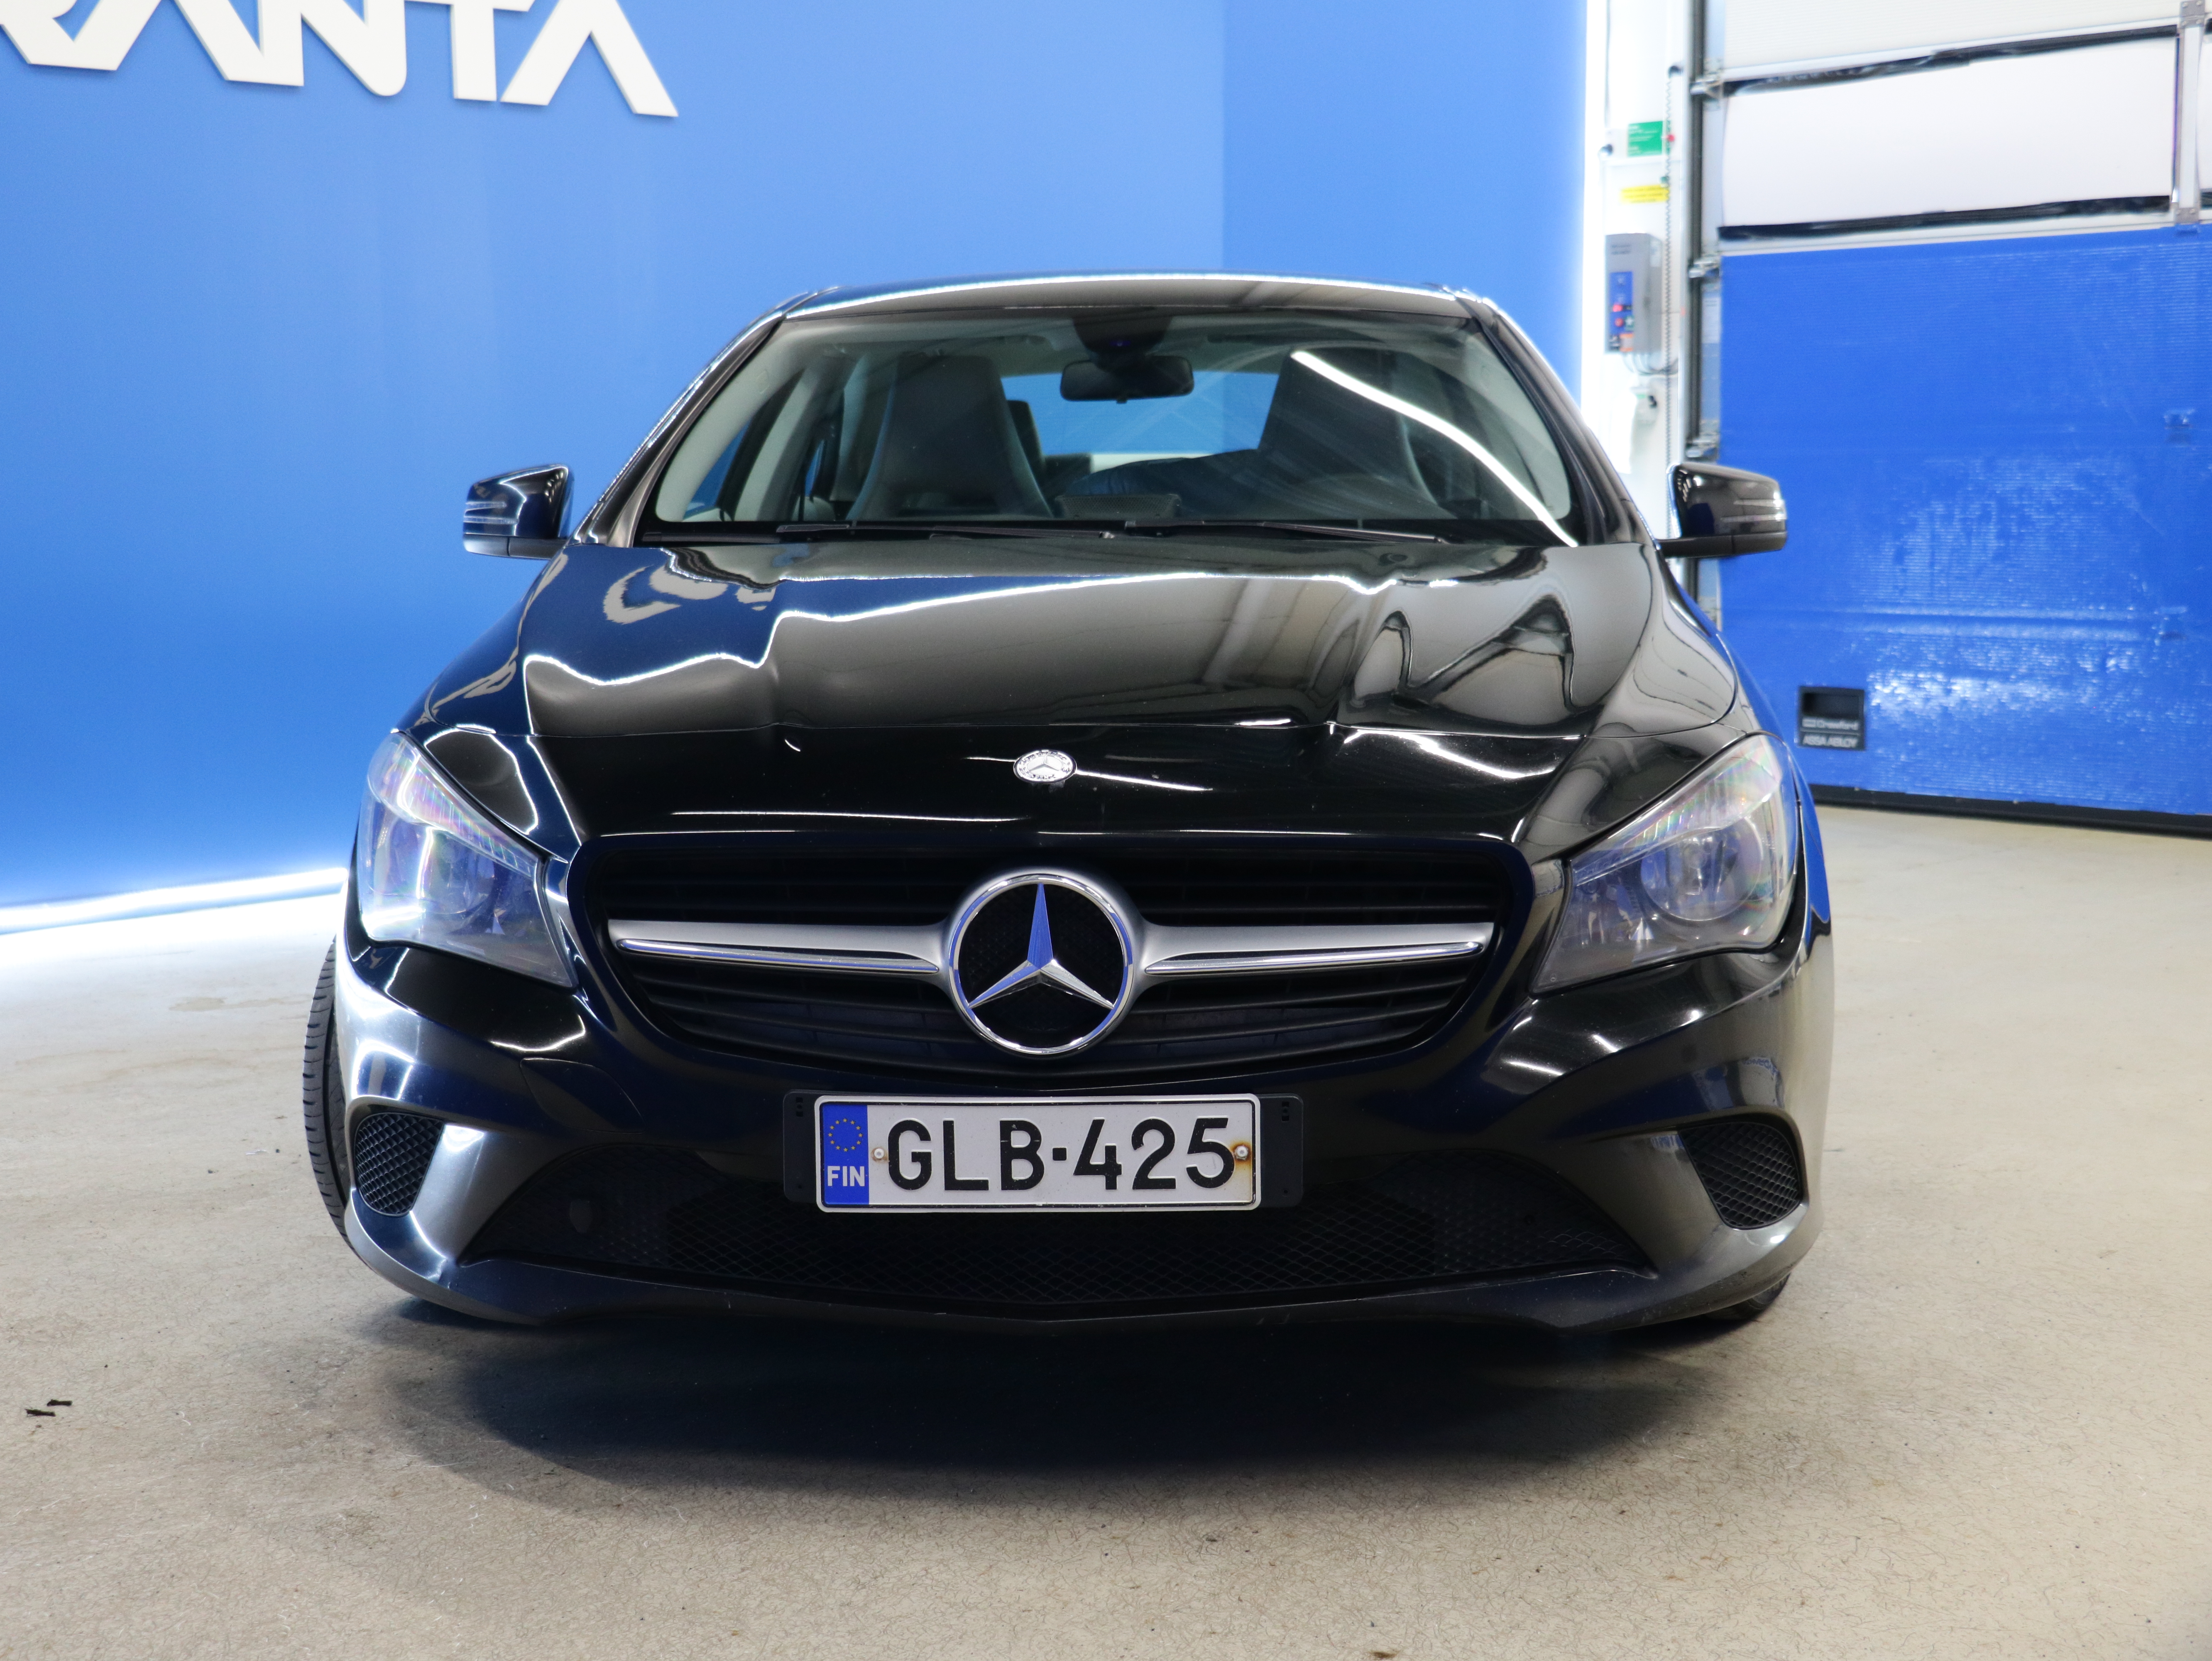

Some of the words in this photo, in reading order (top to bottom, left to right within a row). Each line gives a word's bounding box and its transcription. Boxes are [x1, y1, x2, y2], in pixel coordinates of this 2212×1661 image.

[1803, 735, 1826, 746] ASSA
[1827, 737, 1857, 748] ABLOY
[827, 1165, 866, 1187] FIN
